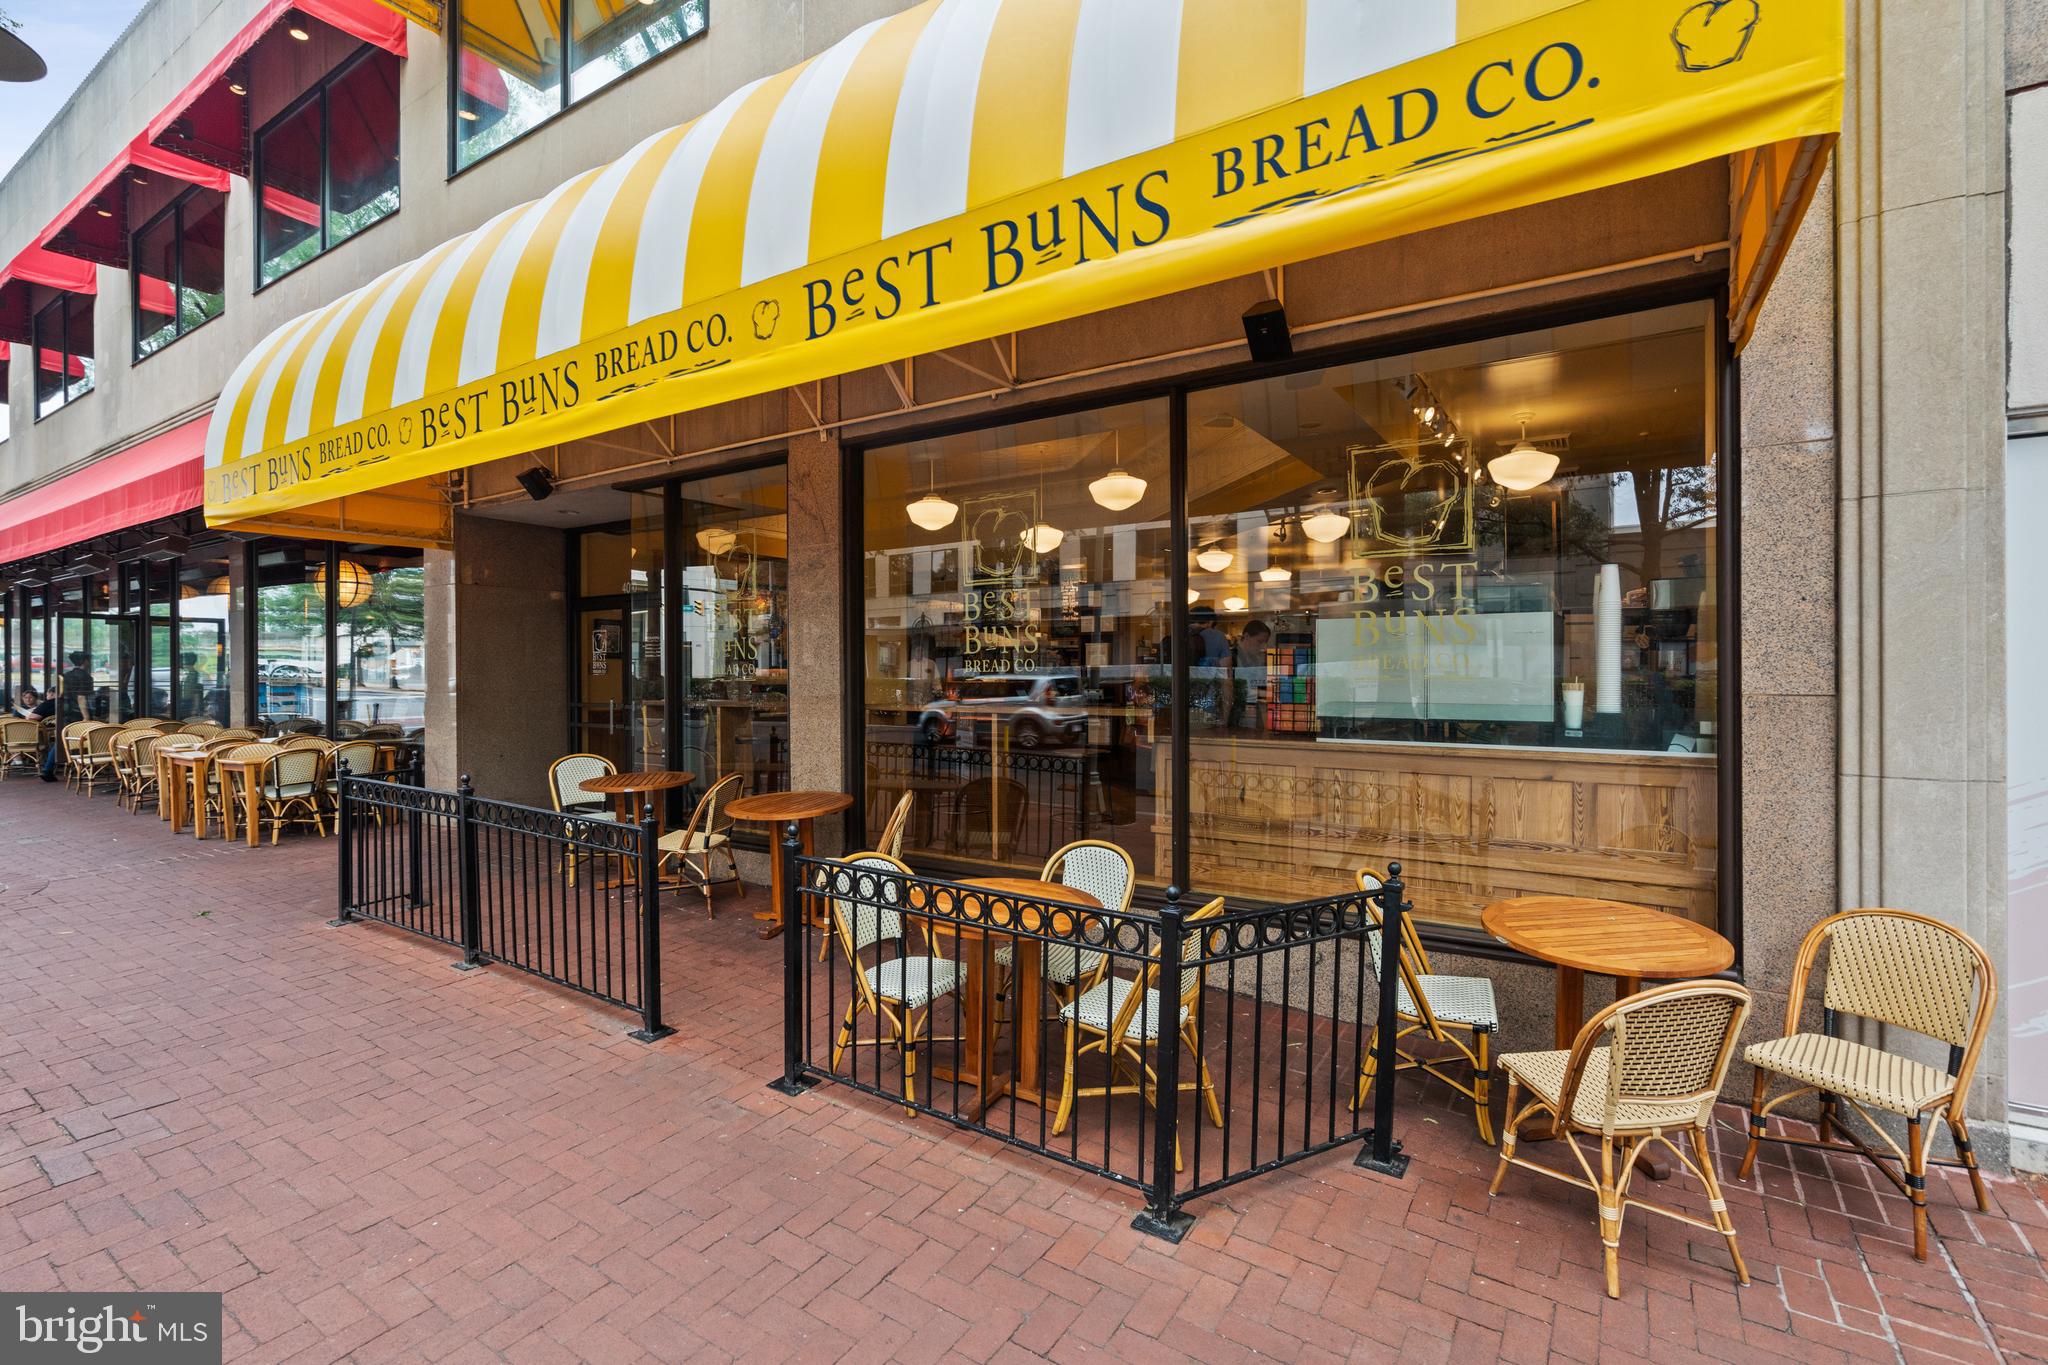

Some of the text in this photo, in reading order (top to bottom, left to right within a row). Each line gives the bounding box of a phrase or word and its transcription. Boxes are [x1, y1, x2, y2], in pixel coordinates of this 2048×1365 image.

[1211, 87, 1438, 198] BREAD
[1466, 41, 1600, 119] CO.
[594, 329, 678, 382] BREAD
[687, 313, 733, 353] CO.
[319, 431, 363, 464] BREAD
[367, 423, 391, 449] CO.
[965, 658, 1038, 673] BREAD CO.
[1352, 653, 1428, 671] EAD
